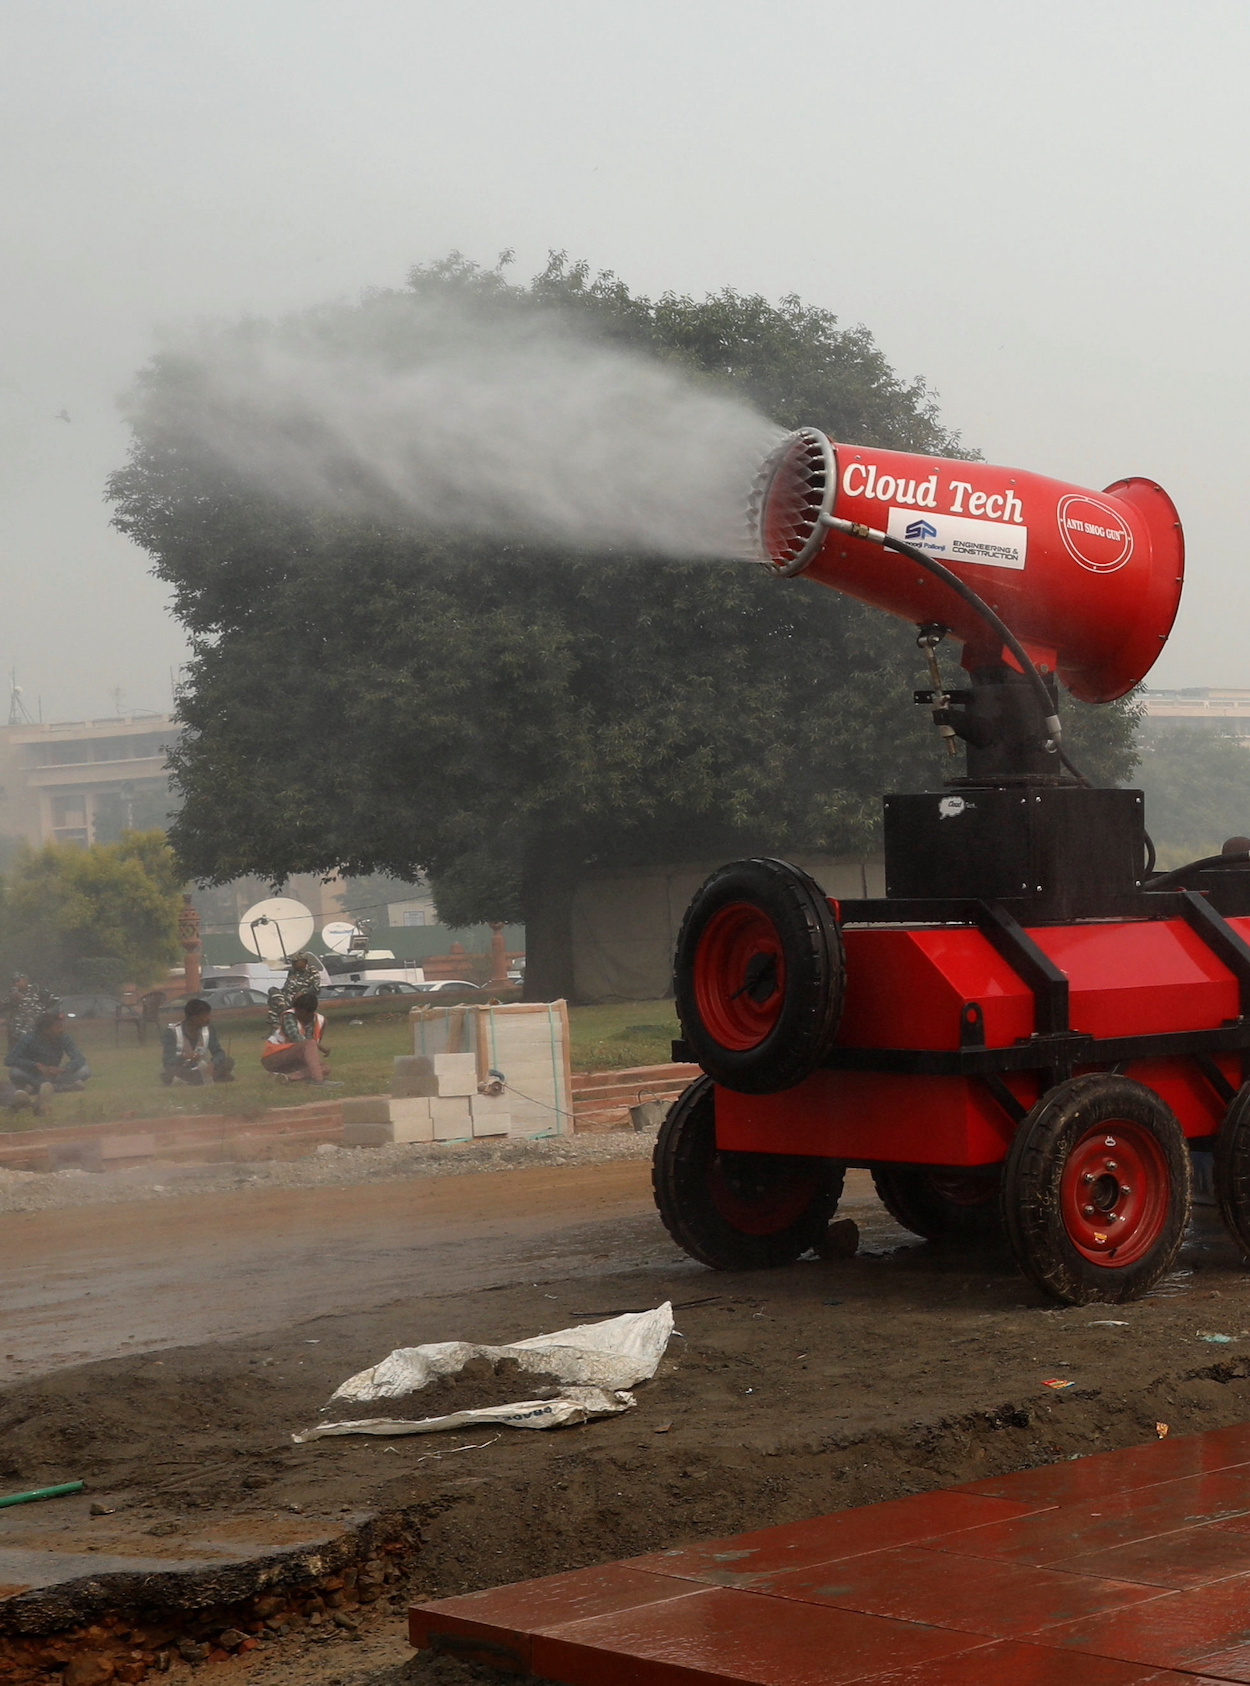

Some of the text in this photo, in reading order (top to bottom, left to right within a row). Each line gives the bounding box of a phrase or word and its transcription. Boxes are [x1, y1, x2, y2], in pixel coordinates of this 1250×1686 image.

[843, 463, 1023, 523] Cloud Tech
[1066, 518, 1120, 541] ANTI SMOG GUN
[952, 546, 1019, 561] CONSTRUCTION
[953, 540, 1011, 554] ENGINEERING
